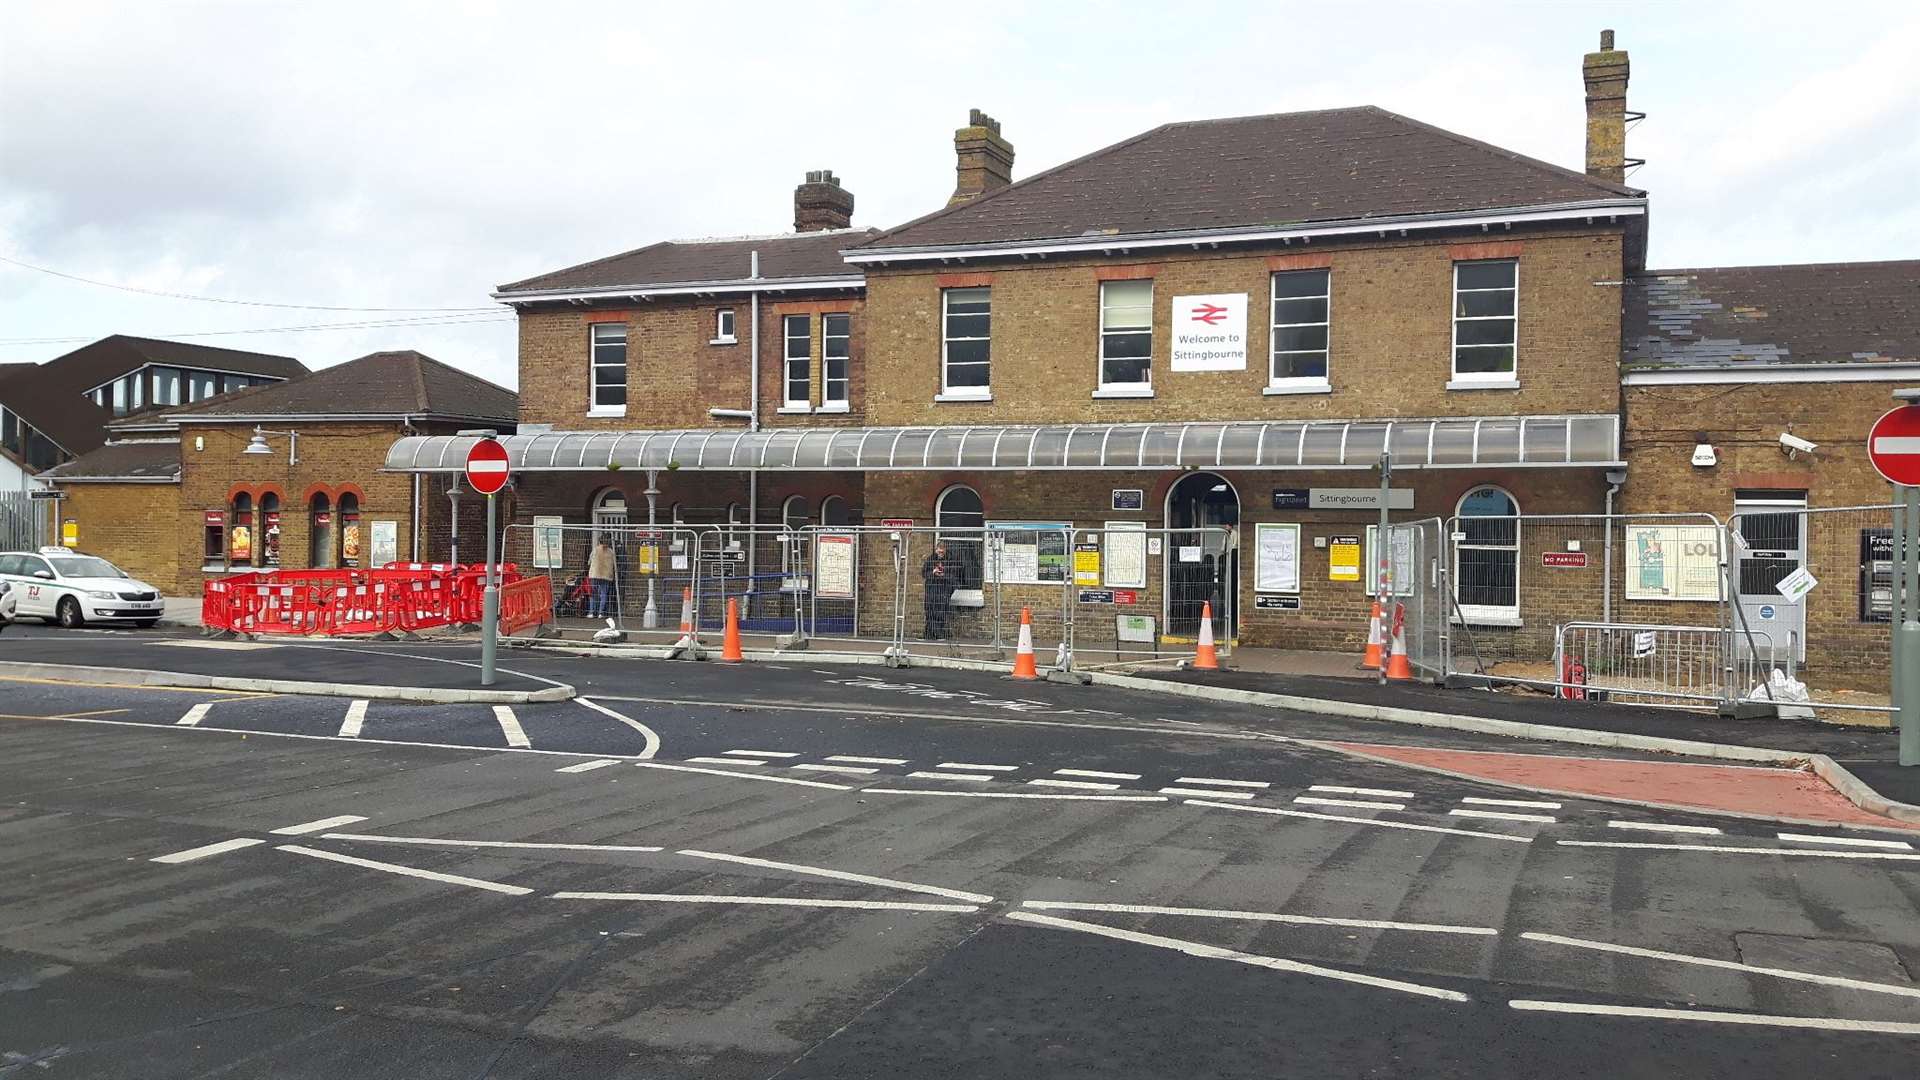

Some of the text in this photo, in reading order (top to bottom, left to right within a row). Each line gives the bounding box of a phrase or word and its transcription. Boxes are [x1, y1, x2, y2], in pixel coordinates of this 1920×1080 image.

[1179, 334, 1240, 344] Welcome to
[1174, 350, 1244, 361] Sittingbourne
[1319, 494, 1377, 504] Sittingbourne
[1870, 535, 1894, 545] Free
[1684, 543, 1717, 556] LOL
[28, 585, 40, 596] TJ
